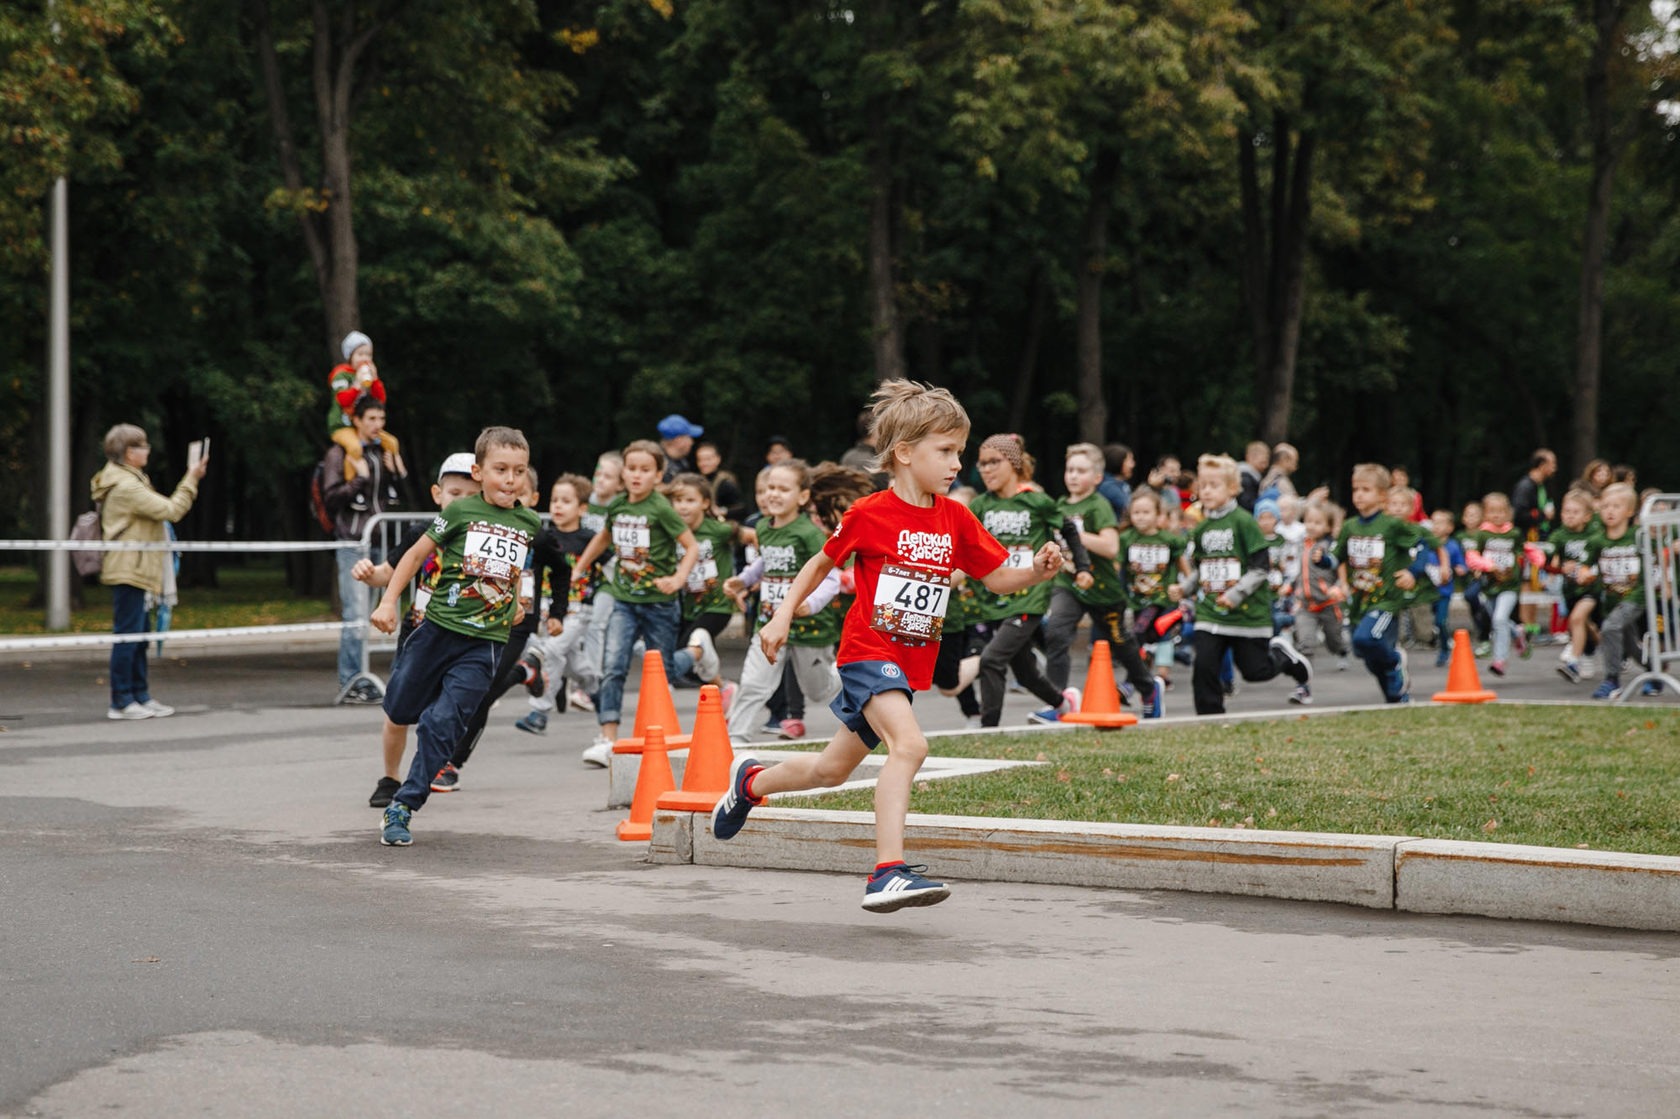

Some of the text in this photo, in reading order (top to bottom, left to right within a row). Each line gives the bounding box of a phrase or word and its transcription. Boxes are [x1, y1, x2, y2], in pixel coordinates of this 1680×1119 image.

[479, 536, 519, 562] 455
[768, 585, 791, 600] 54
[894, 582, 943, 613] 487
